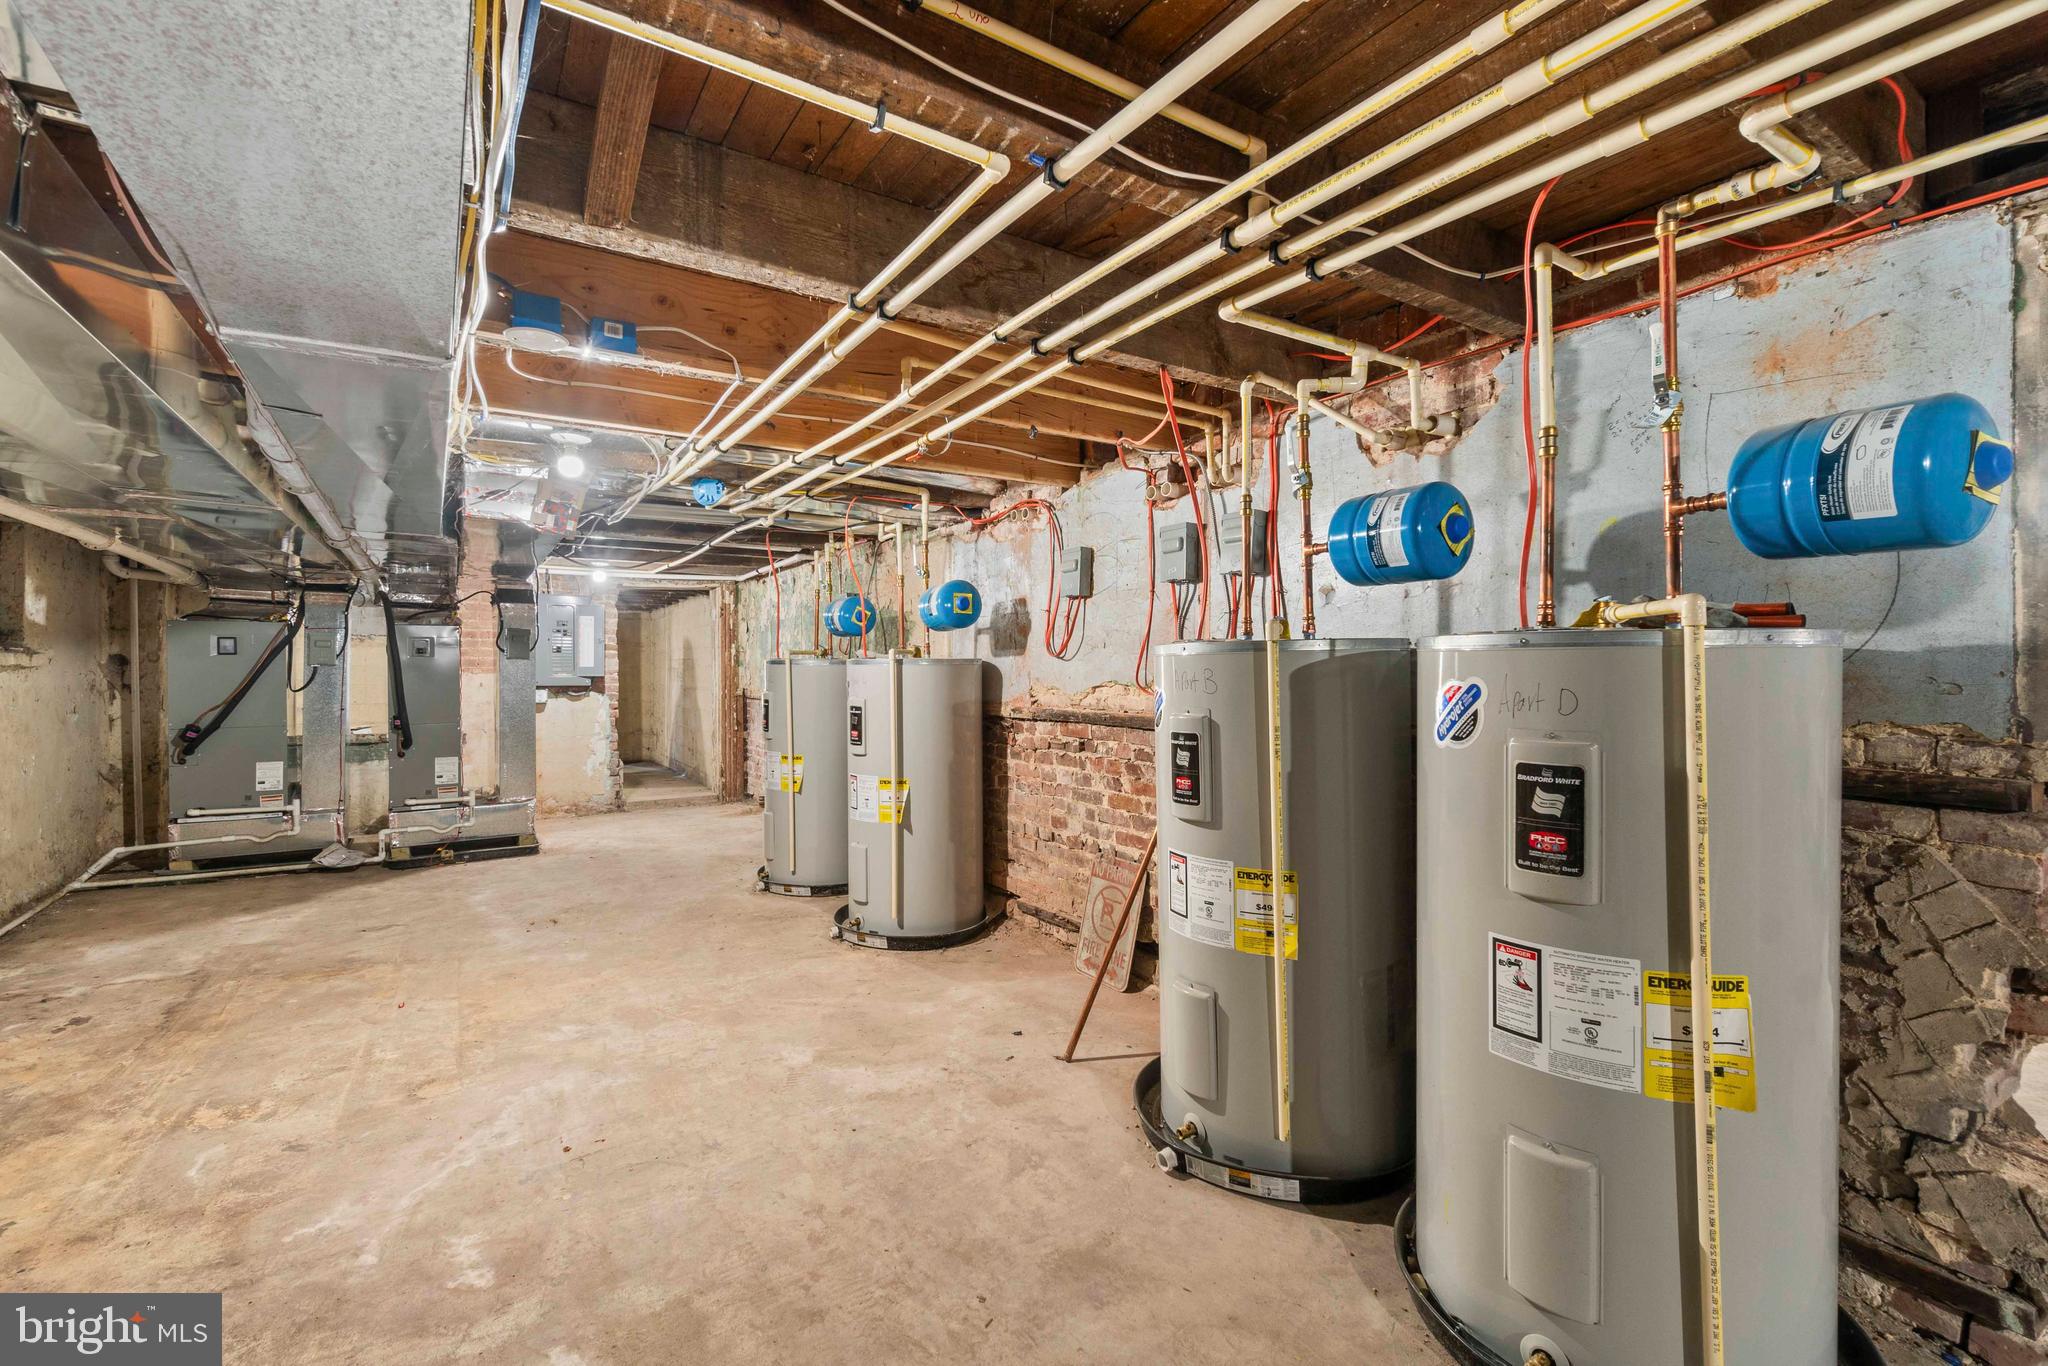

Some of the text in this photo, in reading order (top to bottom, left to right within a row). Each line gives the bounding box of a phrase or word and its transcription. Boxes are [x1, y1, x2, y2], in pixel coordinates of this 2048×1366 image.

[1202, 668, 1218, 695] B
[1557, 688, 1579, 717] D
[1437, 700, 1465, 738] Hydrojet
[1517, 773, 1581, 786] BRADFORD WHITE
[1529, 833, 1567, 845] PHCC
[1256, 903, 1273, 912] $49
[1506, 947, 1532, 959] DANGER
